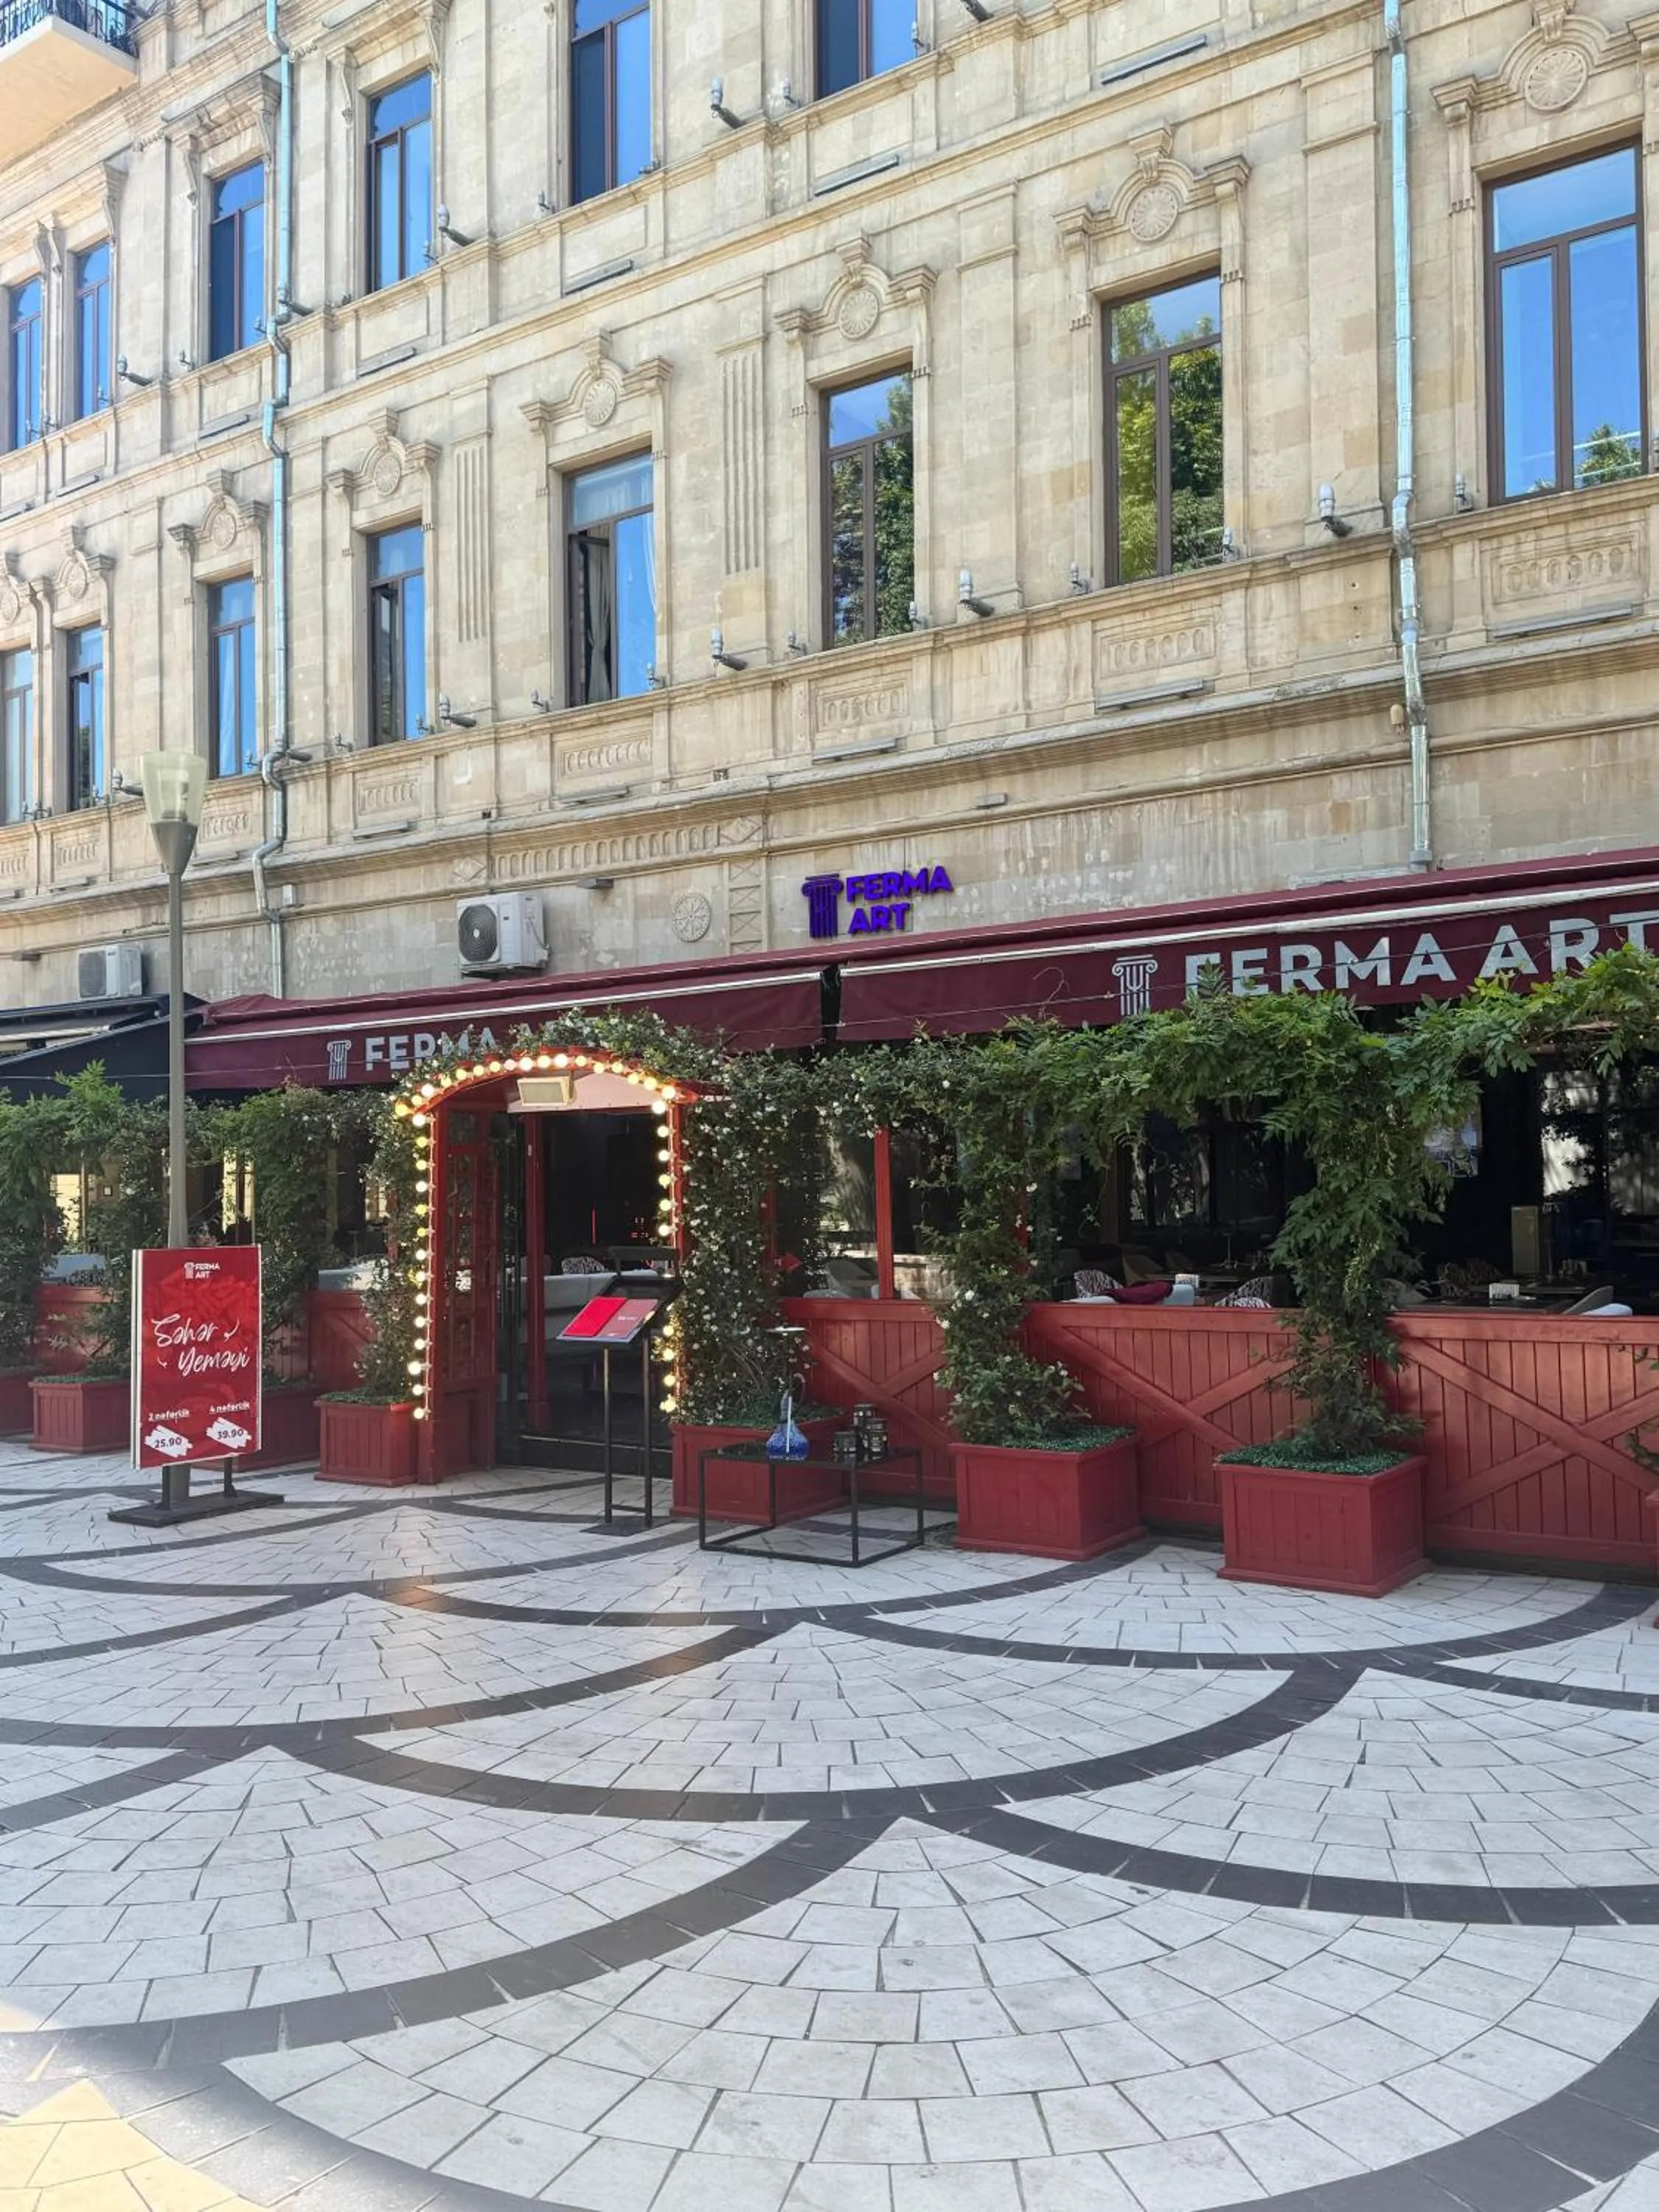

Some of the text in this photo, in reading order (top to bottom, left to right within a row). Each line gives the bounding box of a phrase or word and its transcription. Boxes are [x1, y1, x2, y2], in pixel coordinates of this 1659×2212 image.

[846, 866, 953, 903] FERMA
[849, 902, 911, 935] ART
[1185, 910, 1659, 999] FERMA ART
[195, 1262, 220, 1270] FERMA
[195, 1270, 211, 1279] ART
[150, 1313, 219, 1347] Səhər
[154, 1437, 182, 1449] 25.90
